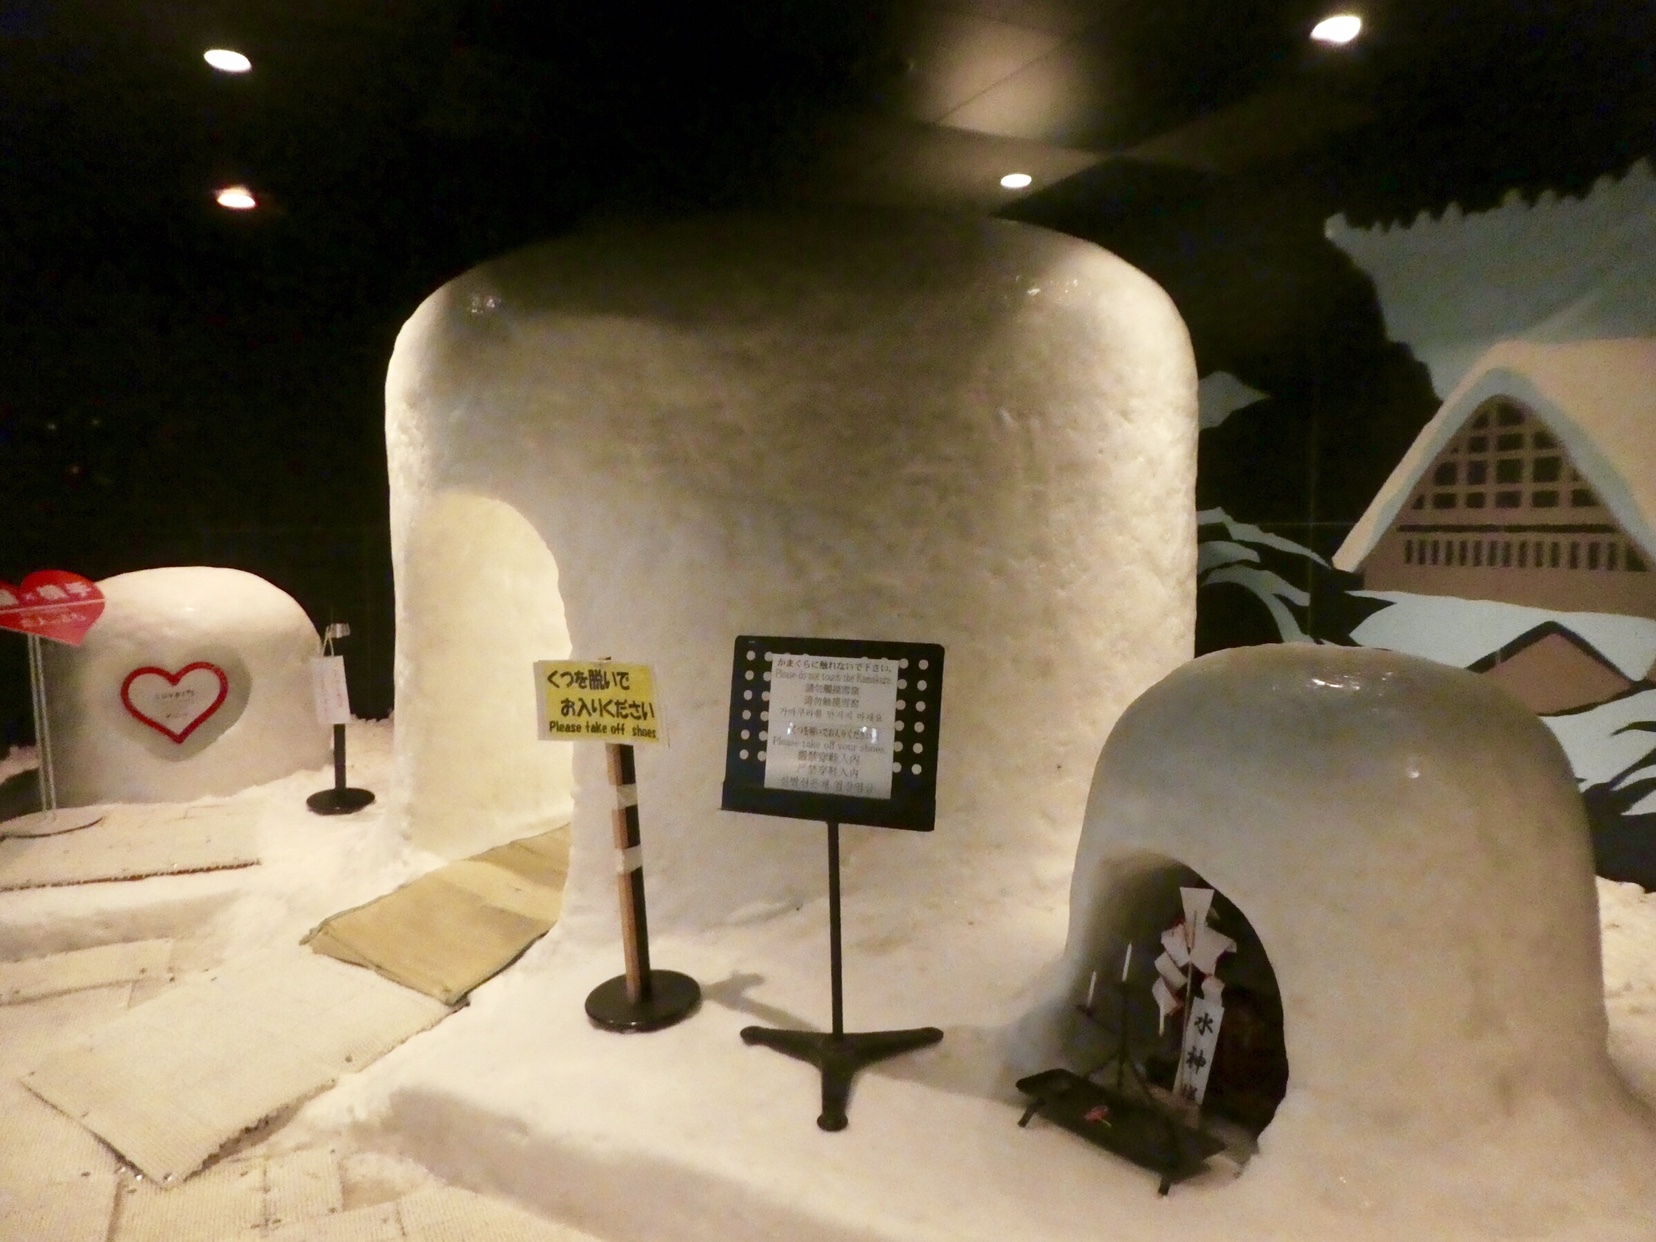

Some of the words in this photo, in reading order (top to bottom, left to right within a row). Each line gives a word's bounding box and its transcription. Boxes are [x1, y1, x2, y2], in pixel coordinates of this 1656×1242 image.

[547, 669, 630, 690] くつを脱いで
[775, 669, 796, 680] Please
[560, 698, 655, 720] お入りください
[549, 721, 582, 733] Please
[586, 721, 607, 734] take
[611, 723, 625, 735] off
[632, 725, 656, 738] shoes
[773, 736, 798, 747] Please
[802, 738, 820, 748] take
[824, 738, 835, 749] off
